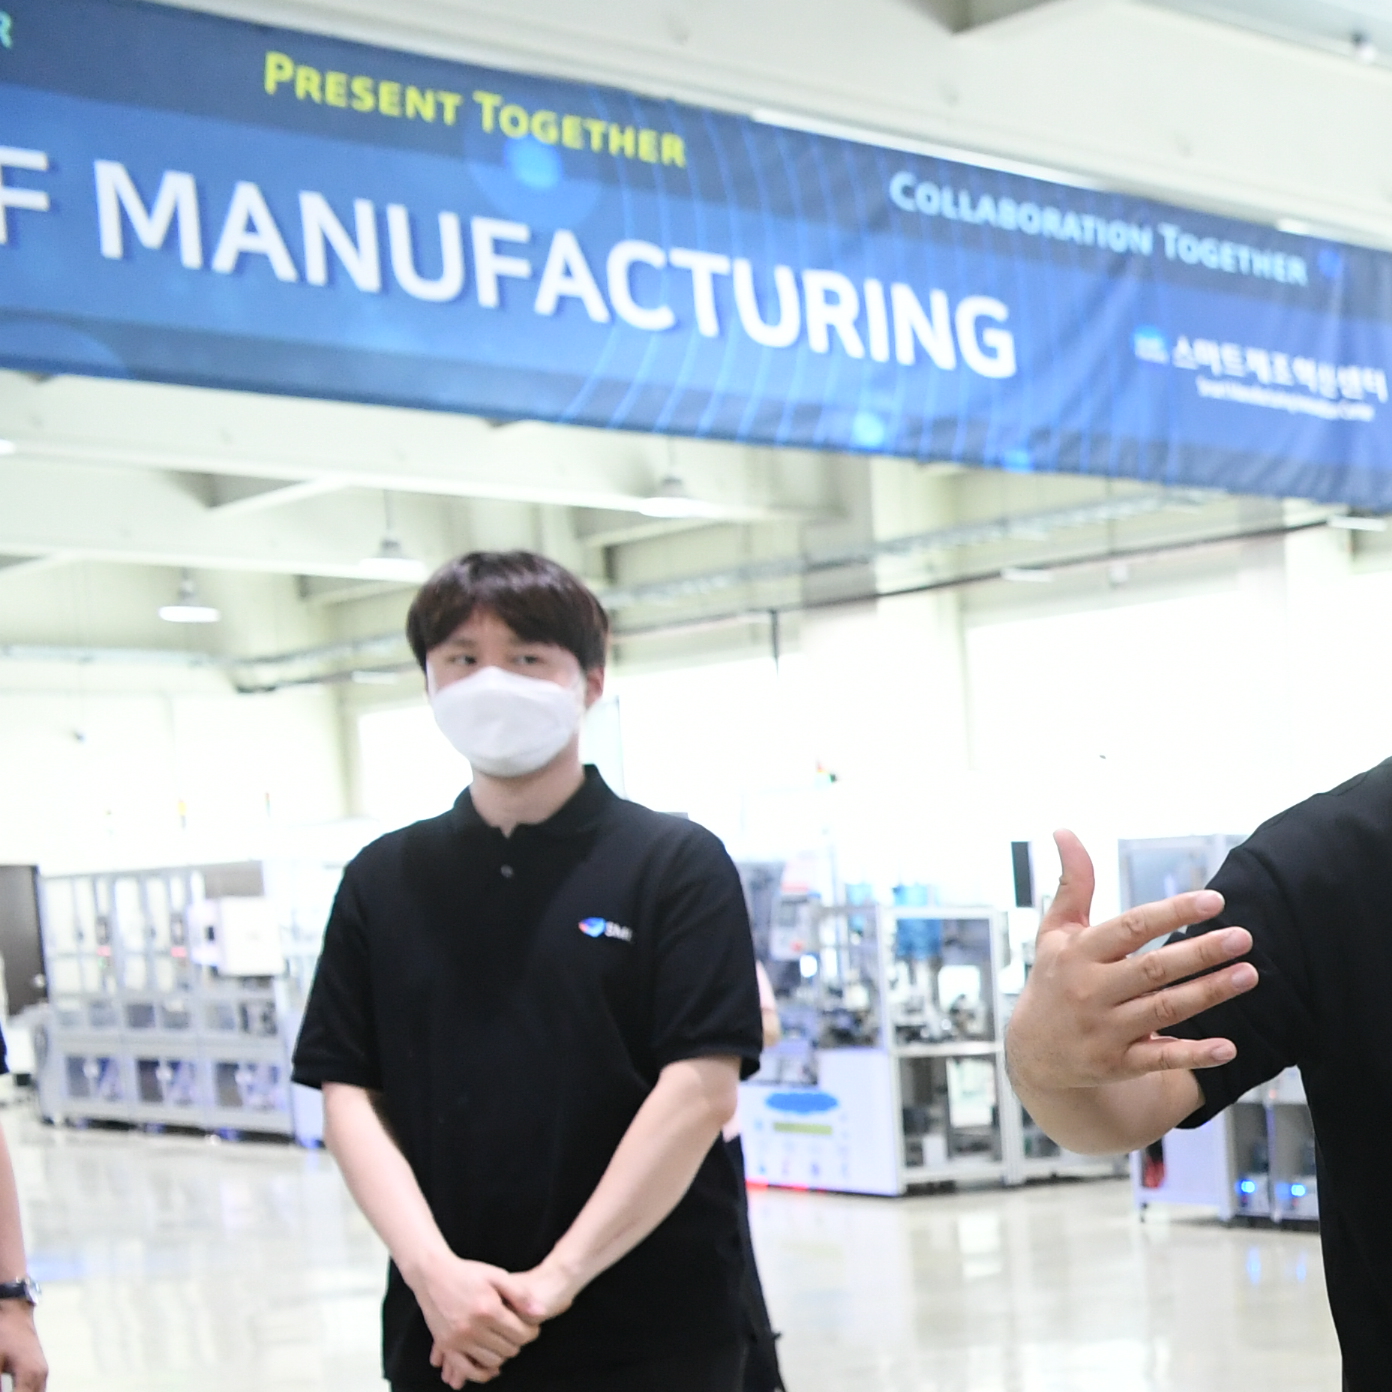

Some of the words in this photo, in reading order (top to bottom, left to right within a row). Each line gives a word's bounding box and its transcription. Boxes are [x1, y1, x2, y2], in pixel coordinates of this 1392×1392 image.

[264, 51, 463, 126] PRESENT
[474, 90, 687, 167] TOGETHER
[93, 159, 1017, 378] MANUFACTURING
[889, 172, 1153, 256] COLLABORATION
[1157, 223, 1308, 286] TOGETHER
